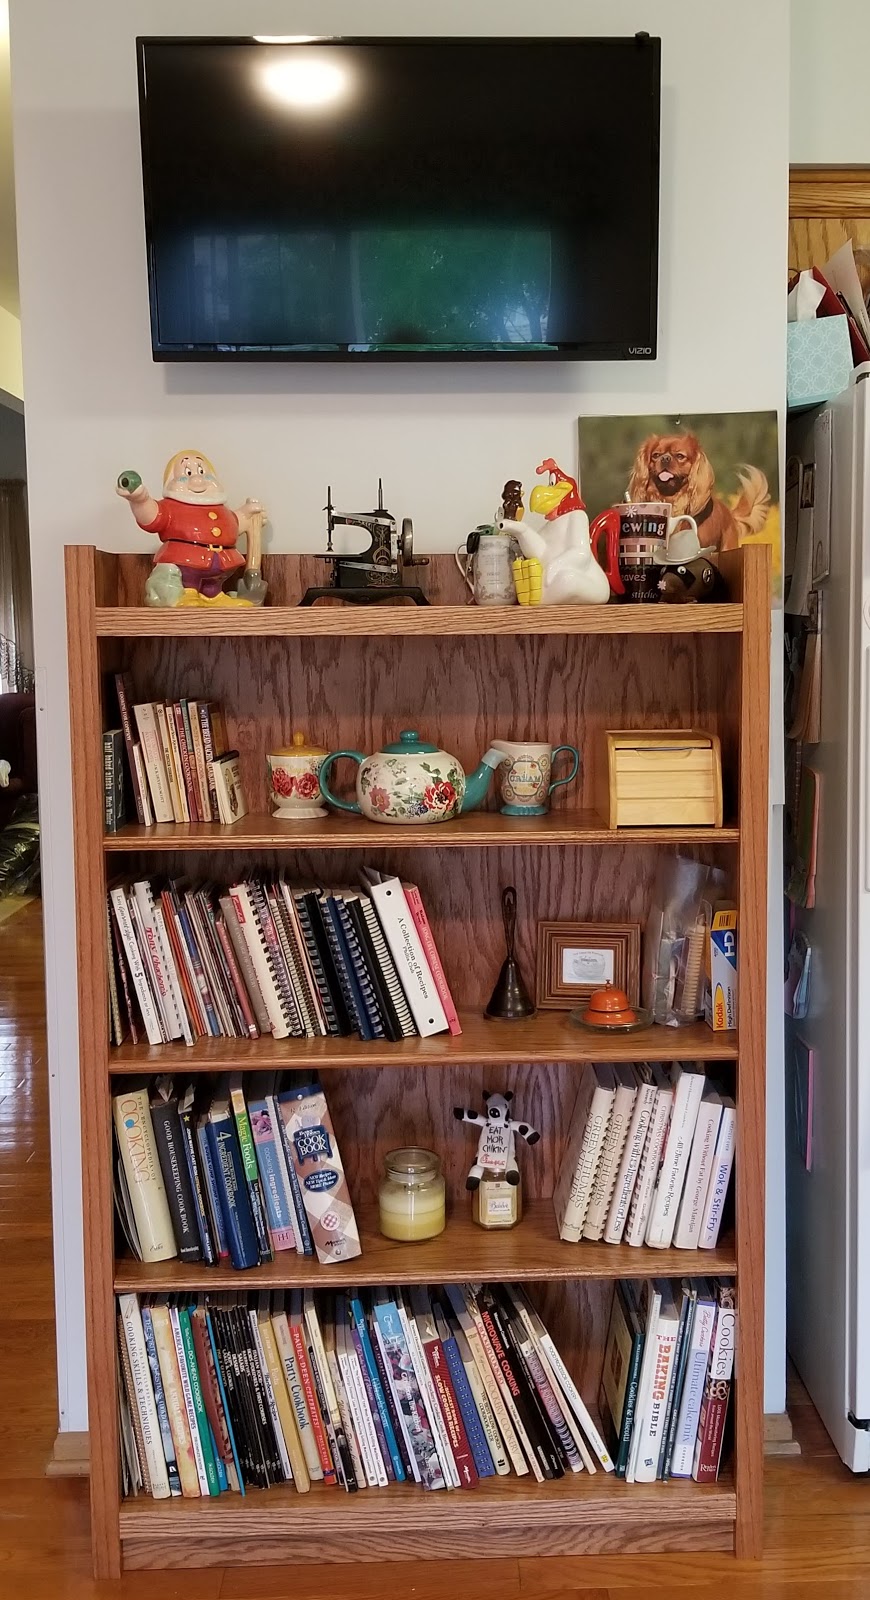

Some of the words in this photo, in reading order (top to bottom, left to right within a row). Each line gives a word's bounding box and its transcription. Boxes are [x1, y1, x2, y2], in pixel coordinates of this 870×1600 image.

[399, 923, 417, 961] Collection
[724, 932, 735, 957] HD
[412, 961, 420, 970] of
[414, 969, 430, 1000] Recipes
[716, 1002, 724, 1028] Kodak
[120, 1098, 150, 1184] COOKING
[163, 1120, 172, 1140] GOOD
[215, 1129, 231, 1141] 4
[236, 1115, 250, 1142] Magic
[298, 1134, 325, 1148] COOK
[486, 1136, 503, 1144] MOR
[489, 1126, 502, 1134] EAT
[582, 1121, 592, 1144] THE
[586, 1114, 603, 1155] GREEN
[607, 1113, 624, 1153] GREEN
[633, 1109, 650, 1142] Cooking
[703, 1118, 714, 1143] Cooking
[217, 1141, 230, 1176] INGREDIENT
[241, 1142, 255, 1169] Foods
[262, 1146, 274, 1173] cooking
[300, 1143, 327, 1156] BOOK
[630, 1141, 642, 1159] with
[699, 1143, 709, 1166] Without
[166, 1141, 181, 1192] HOUSEKEEPING
[568, 1148, 586, 1202] KITCHEN
[593, 1156, 613, 1207] THUMBS
[668, 1166, 678, 1191] Favorite
[716, 1163, 728, 1187] Wok
[223, 1175, 236, 1208] COOKBOOK
[267, 1173, 284, 1218] ingredients
[574, 1157, 593, 1208] THUMBS
[617, 1167, 636, 1208] Ingredients
[691, 1185, 702, 1206] George
[714, 1187, 723, 1195] &
[176, 1193, 185, 1214] COOK
[661, 1190, 675, 1217] Recipes
[705, 1197, 721, 1232] Stir-Fry
[179, 1213, 189, 1233] BOOK
[613, 1215, 625, 1232] Less
[293, 1332, 304, 1360] PAULA
[299, 1360, 310, 1384] DEEN
[480, 1310, 505, 1358] MICROWAVE
[500, 1358, 520, 1396] COOKING
[716, 1313, 736, 1376] Cookies
[236, 1352, 246, 1372] SALADS
[282, 1356, 299, 1383] Party
[489, 1354, 505, 1385] COOKERY
[547, 1345, 557, 1358] FOOD
[553, 1357, 568, 1381] PROCESSOR
[564, 1379, 577, 1400] COOKERY
[652, 1343, 671, 1401] BAKING
[688, 1350, 706, 1398] Ultimate
[125, 1320, 138, 1358] COOKING
[132, 1358, 143, 1386] SKILLS
[138, 1396, 153, 1445] TECHNIQUES
[173, 1327, 183, 1354] AMERICA'S
[178, 1354, 187, 1378] FAVORITE
[187, 1408, 196, 1429] RECIPES
[188, 1350, 197, 1381] DO-AHEAD
[193, 1381, 203, 1413] COOKBOOK
[263, 1372, 273, 1398] Barbecue
[268, 1400, 278, 1421] Recipes
[290, 1383, 310, 1429] Cookbook
[444, 1387, 453, 1408] BIGGEST
[450, 1409, 458, 1424] BOOK
[454, 1423, 460, 1432] OF
[627, 1381, 636, 1407] Cookies
[685, 1397, 698, 1422] cake
[410, 1410, 422, 1432] Kitchen
[425, 1380, 437, 1402] Crockery
[432, 1402, 441, 1418] Cooker
[437, 1419, 445, 1433] Cook
[441, 1433, 449, 1446] Book
[434, 1373, 444, 1393] SLOW
[439, 1393, 452, 1421] COOKER
[447, 1420, 460, 1448] RECIPES
[478, 1402, 489, 1428] COOKBOOK
[483, 1402, 491, 1414] BEST
[487, 1414, 495, 1429] SLOW
[491, 1429, 502, 1450] COOKER
[484, 1374, 506, 1416] CROCKERY
[499, 1416, 519, 1455] COOKERY
[648, 1402, 660, 1437] BIBLE
[622, 1416, 632, 1442] Biscotti
[682, 1423, 694, 1443] mix
